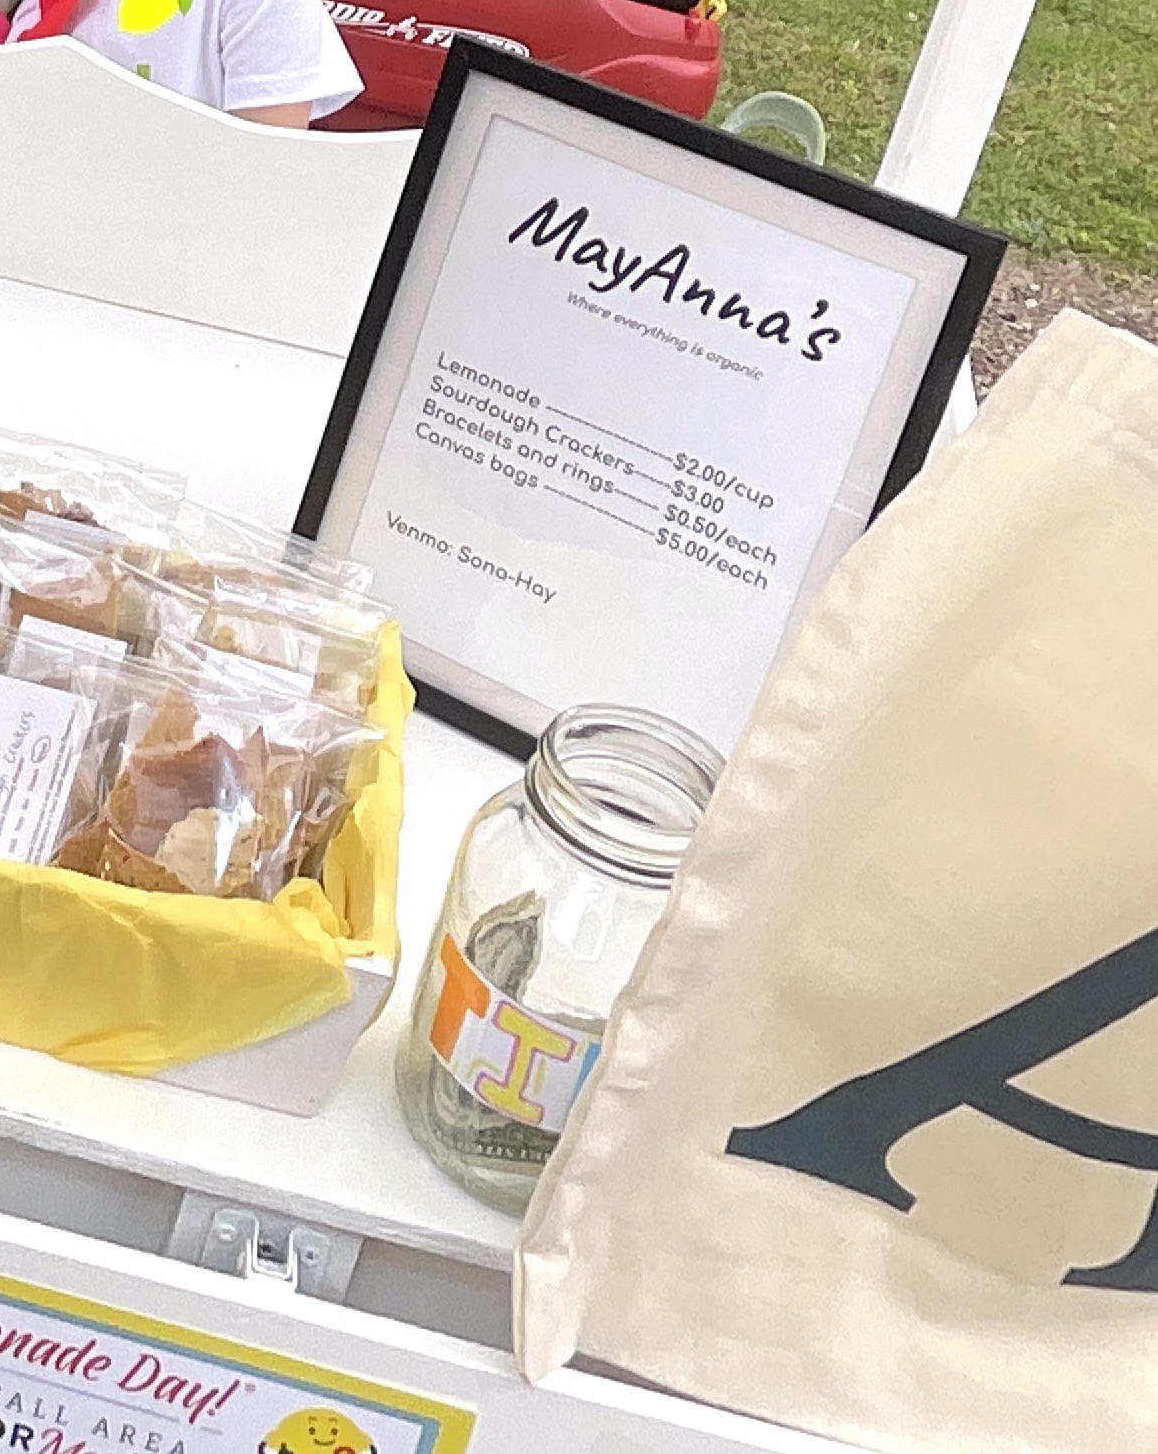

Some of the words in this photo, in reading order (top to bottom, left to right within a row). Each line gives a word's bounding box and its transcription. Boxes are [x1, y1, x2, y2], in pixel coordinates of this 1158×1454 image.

[509, 197, 840, 361] MayAnna's
[567, 292, 611, 318] Where
[613, 315, 687, 352] everything
[690, 340, 704, 359] is
[706, 352, 763, 380] organic
[437, 351, 540, 408] Lemonade
[415, 423, 485, 464] Canvas
[491, 457, 538, 487] bags
[431, 375, 539, 435] Sourdough
[545, 425, 634, 475] Crackers
[671, 480, 724, 513] $3.00
[423, 399, 511, 449] Bracelets
[517, 445, 558, 467] and
[562, 463, 616, 493] rings
[664, 504, 776, 566] $0.50/each
[387, 511, 453, 555] Venmo:
[117, 1355, 239, 1418] Day!
[92, 1419, 183, 1454] AREA
